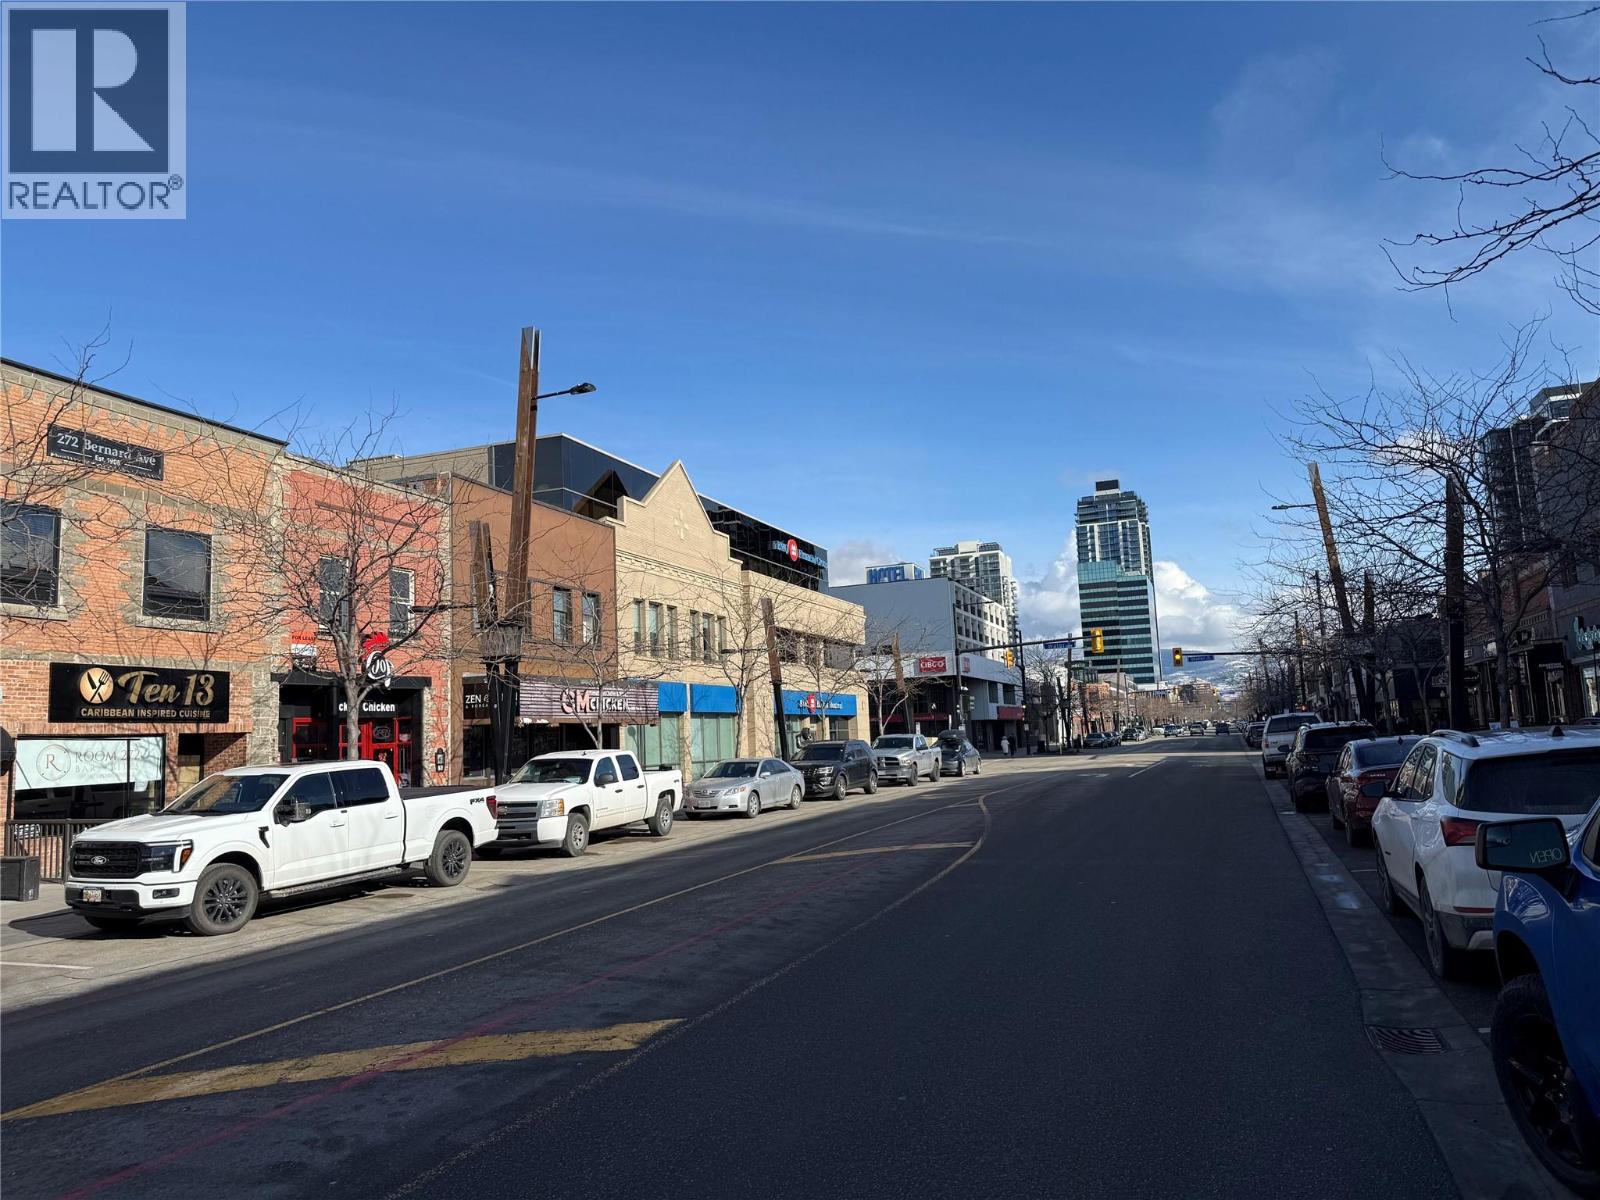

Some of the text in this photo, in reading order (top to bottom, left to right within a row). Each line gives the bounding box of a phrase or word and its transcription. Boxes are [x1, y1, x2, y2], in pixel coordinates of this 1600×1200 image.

[57, 433, 79, 449] 272
[83, 437, 132, 460] Bernard
[136, 451, 156, 467] Ave
[867, 566, 905, 584] HOTEL
[117, 670, 215, 706] Ten 13
[465, 694, 482, 704] ZEN
[362, 701, 396, 712] Chicken
[80, 707, 211, 719] CARIBBEAN INSPIRED CUISINE
[75, 750, 117, 762] ROOM
